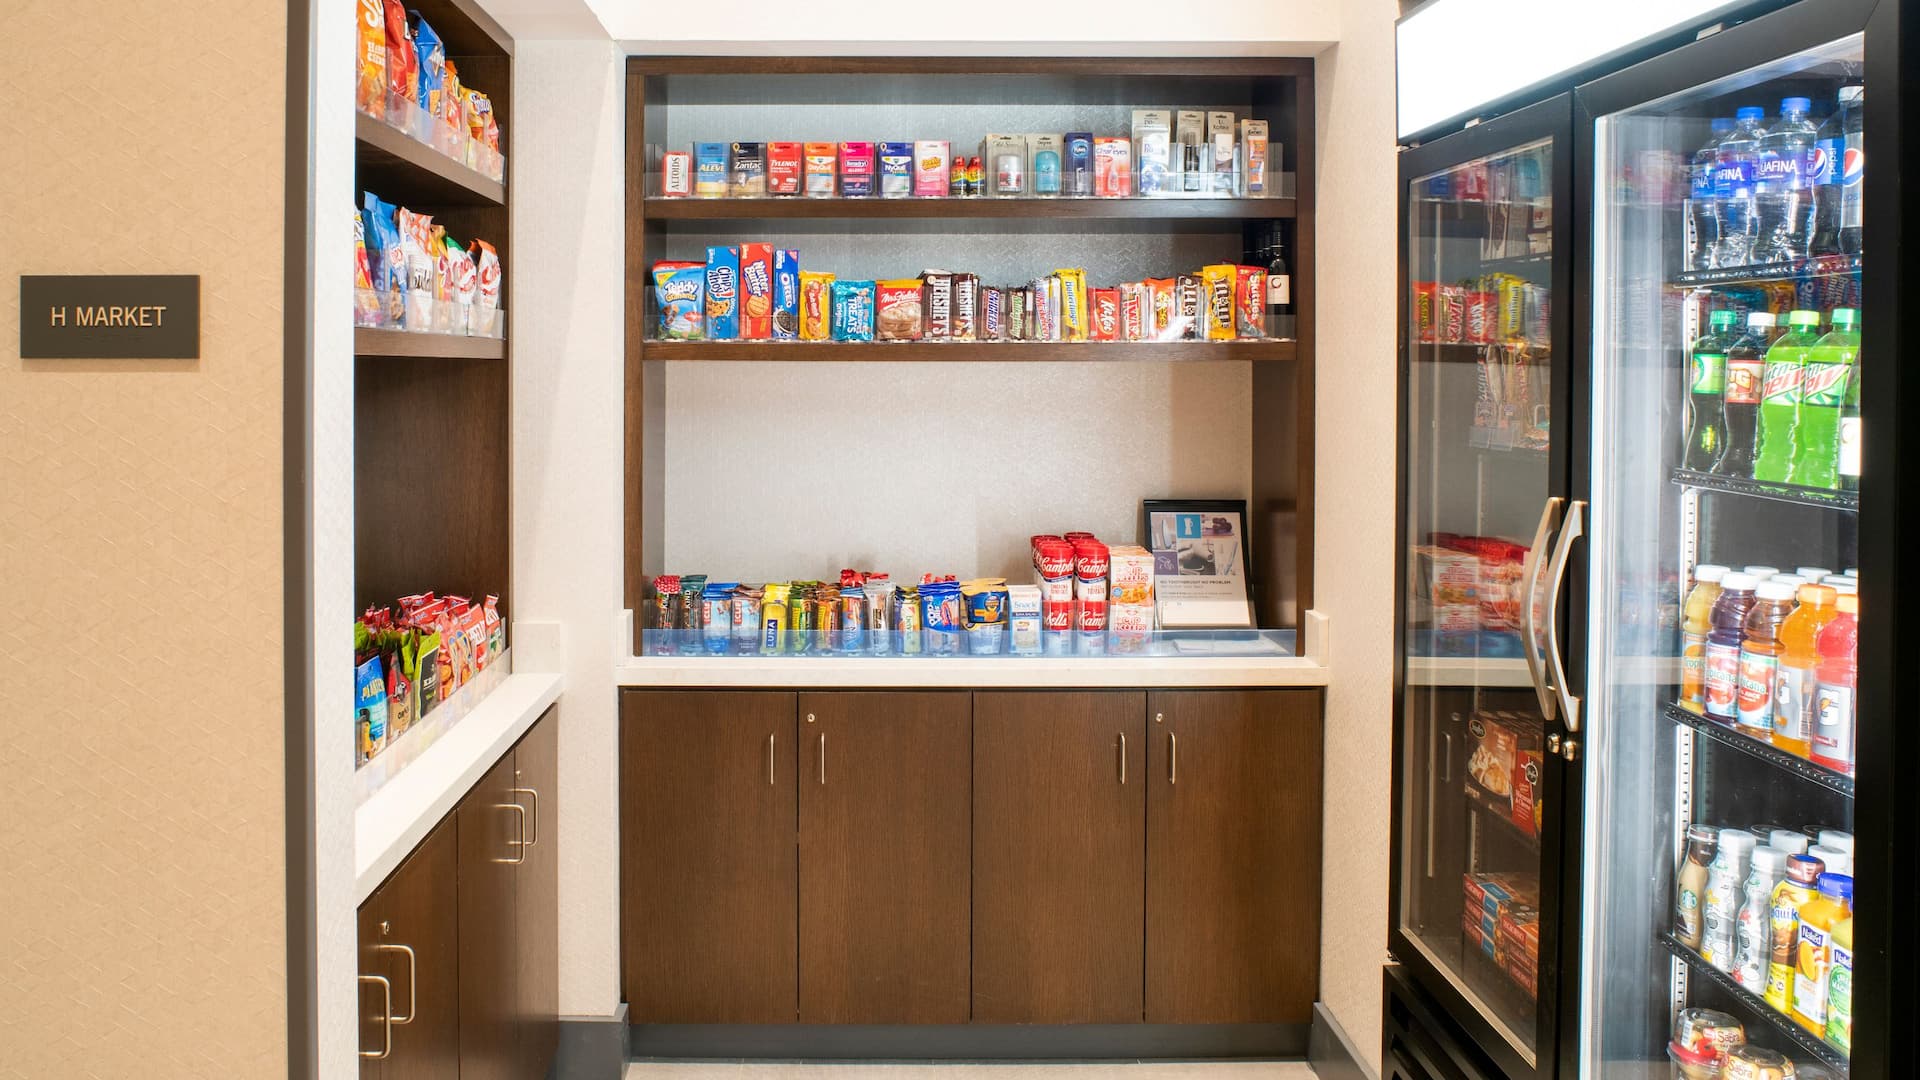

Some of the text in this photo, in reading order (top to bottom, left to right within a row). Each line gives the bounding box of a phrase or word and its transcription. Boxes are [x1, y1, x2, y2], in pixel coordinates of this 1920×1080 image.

[671, 157, 680, 190] ALTOIDS
[734, 161, 763, 169] Zantac
[1828, 147, 1838, 175] pepsi
[664, 280, 699, 295] Teddy
[717, 266, 732, 293] Chips
[744, 267, 763, 297] Butter
[753, 260, 769, 293] Nutter
[780, 272, 792, 308] OREO
[932, 277, 950, 335] HERSHEY'S
[988, 289, 1000, 333] SNICKERS
[1249, 274, 1261, 321] Skittles
[51, 306, 167, 327] H MARKET
[847, 297, 858, 334] TREATS
[768, 620, 776, 647] LUNA
[1802, 927, 1823, 946] Naked
[1717, 1030, 1740, 1043] Sabra
